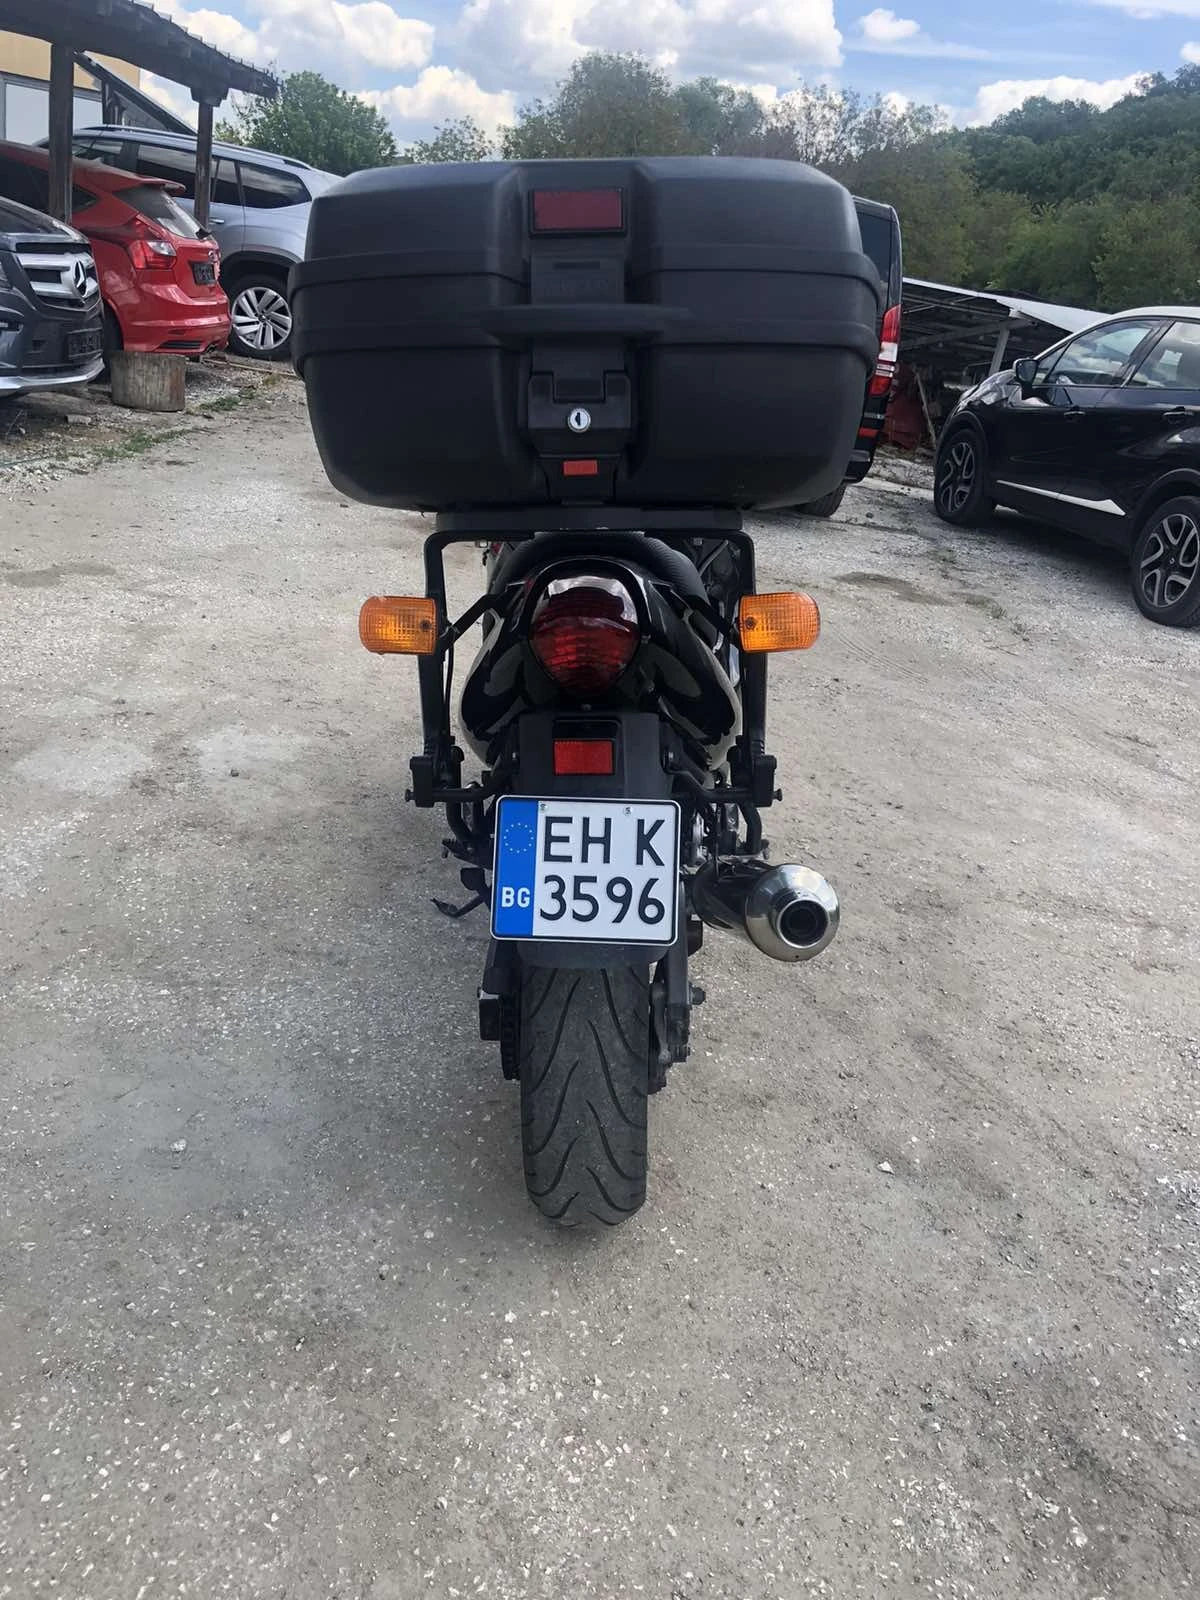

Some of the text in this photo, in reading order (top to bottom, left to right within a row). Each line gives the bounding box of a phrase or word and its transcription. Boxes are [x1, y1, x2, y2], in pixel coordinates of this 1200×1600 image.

[543, 815, 665, 867] EH K
[501, 886, 530, 908] BG
[539, 874, 666, 925] 3596
